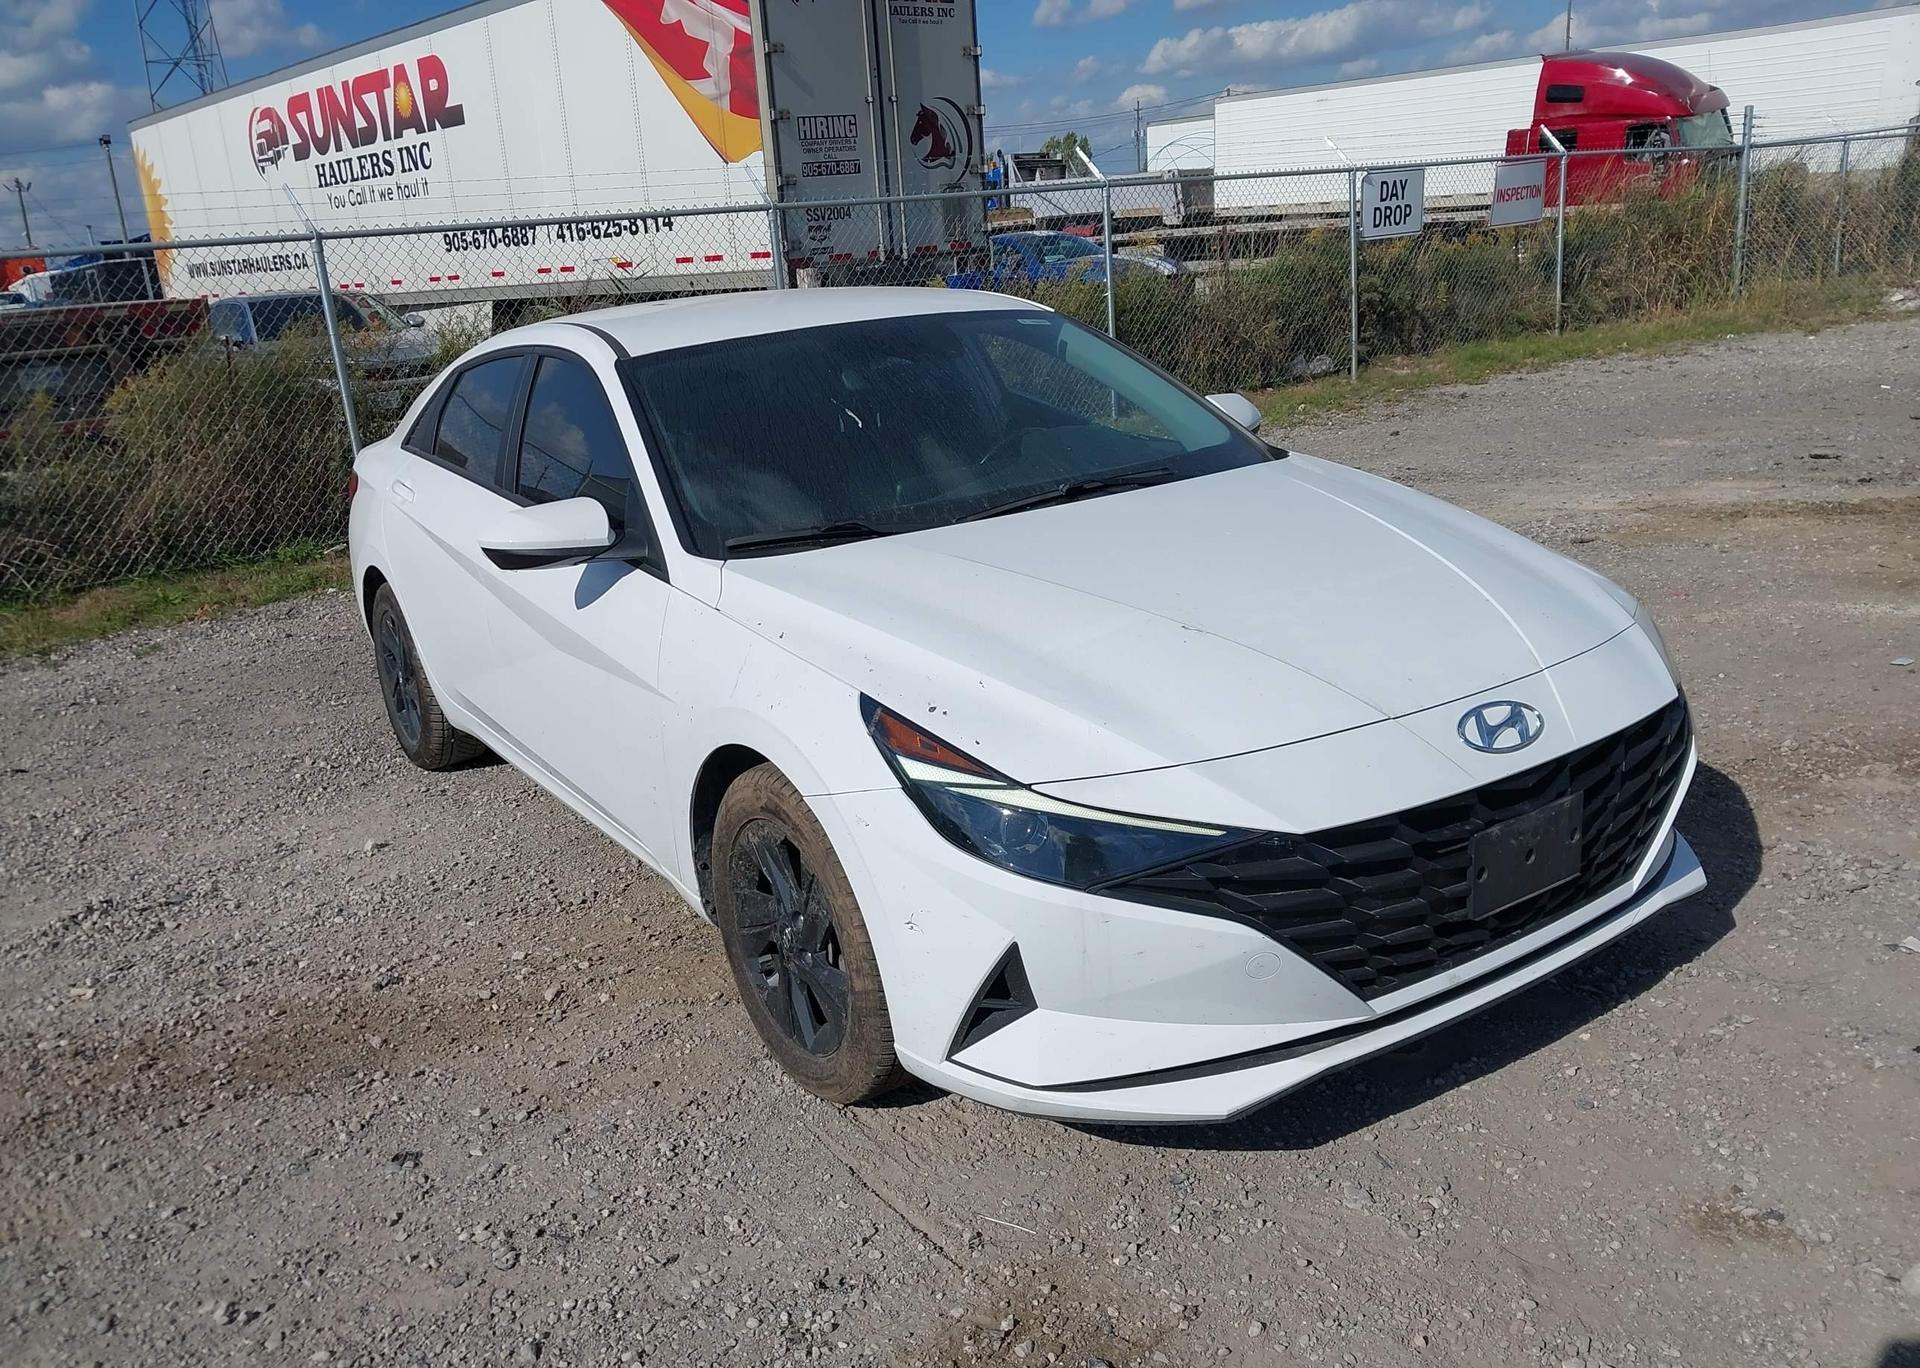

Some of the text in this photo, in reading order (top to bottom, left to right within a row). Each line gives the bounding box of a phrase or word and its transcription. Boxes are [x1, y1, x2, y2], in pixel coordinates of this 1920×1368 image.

[936, 7, 955, 18] INC
[287, 54, 465, 162] SUNSTAR
[798, 116, 857, 139] HIRING
[315, 141, 432, 188] HAULERS INC
[802, 161, 860, 177] 905-670-6887
[327, 192, 346, 209] You
[348, 186, 367, 206] Call
[378, 187, 393, 201] we
[396, 178, 420, 200] haul
[421, 177, 429, 196] it
[1379, 178, 1408, 203] DAY
[1496, 184, 1542, 203] INSPECTION
[806, 206, 852, 222] SSV2004
[1373, 203, 1412, 229] DROP
[187, 253, 310, 278] WWW.SUNSTARHAULERS.CA
